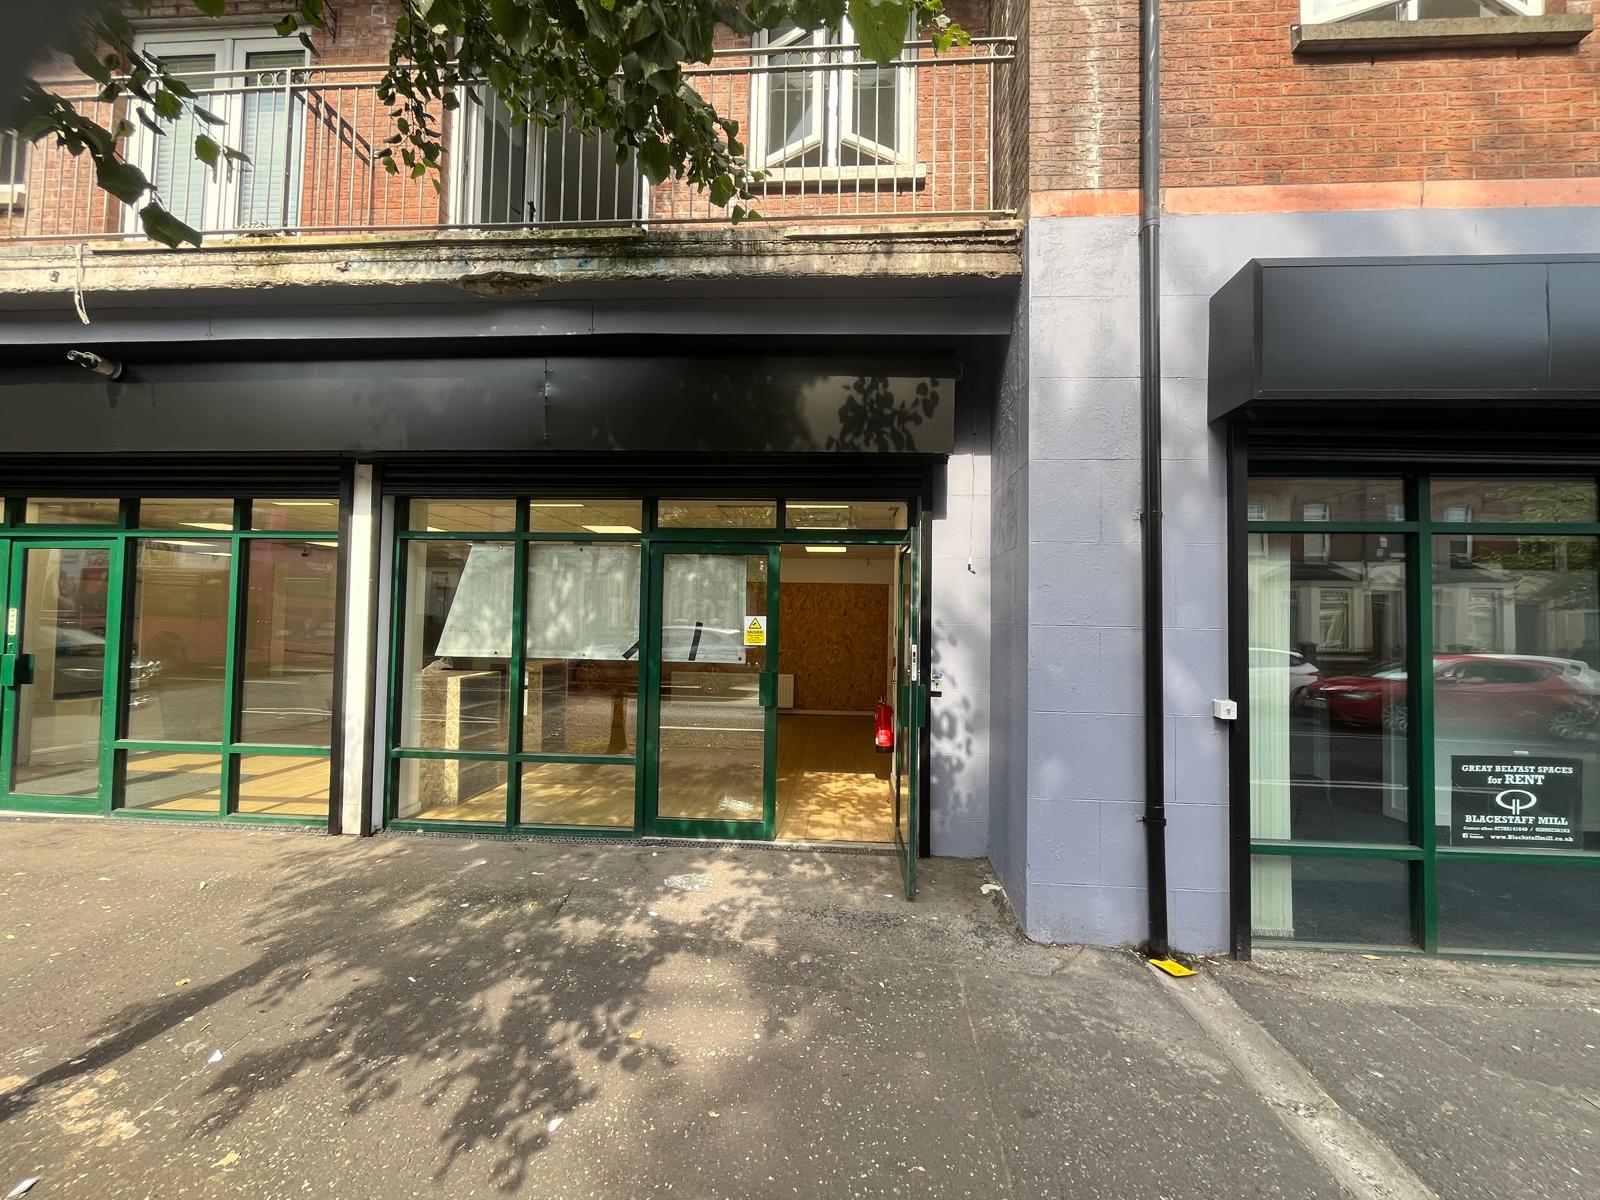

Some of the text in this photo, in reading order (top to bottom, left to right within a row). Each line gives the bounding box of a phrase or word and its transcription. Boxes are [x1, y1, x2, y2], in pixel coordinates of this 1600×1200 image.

[1487, 774, 1545, 785] for RENT
[1465, 815, 1569, 825] BLACKSTAFF MILL
